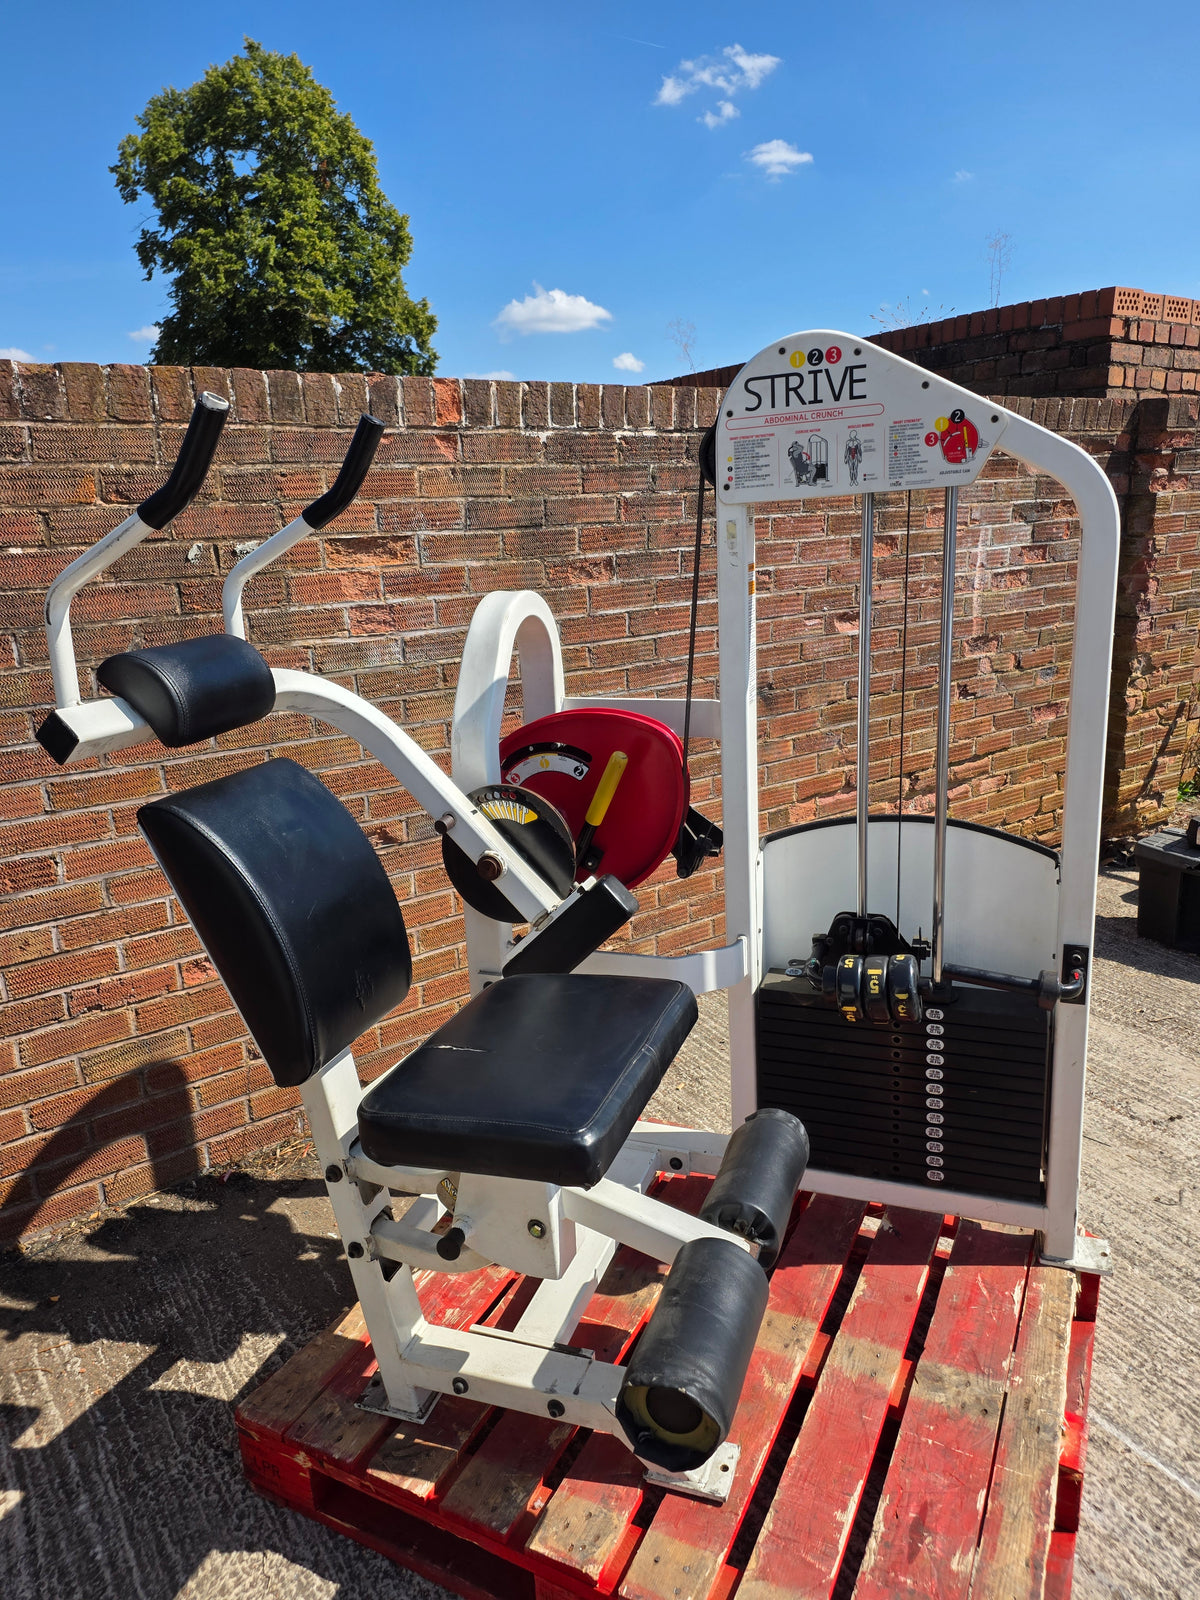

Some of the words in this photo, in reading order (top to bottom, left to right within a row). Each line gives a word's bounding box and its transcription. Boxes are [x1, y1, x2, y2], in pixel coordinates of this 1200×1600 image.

[744, 364, 867, 412] STRIVE
[764, 413, 808, 425] ABDOMINAL
[811, 410, 844, 420] CRUNCH
[870, 979, 880, 994] 5
